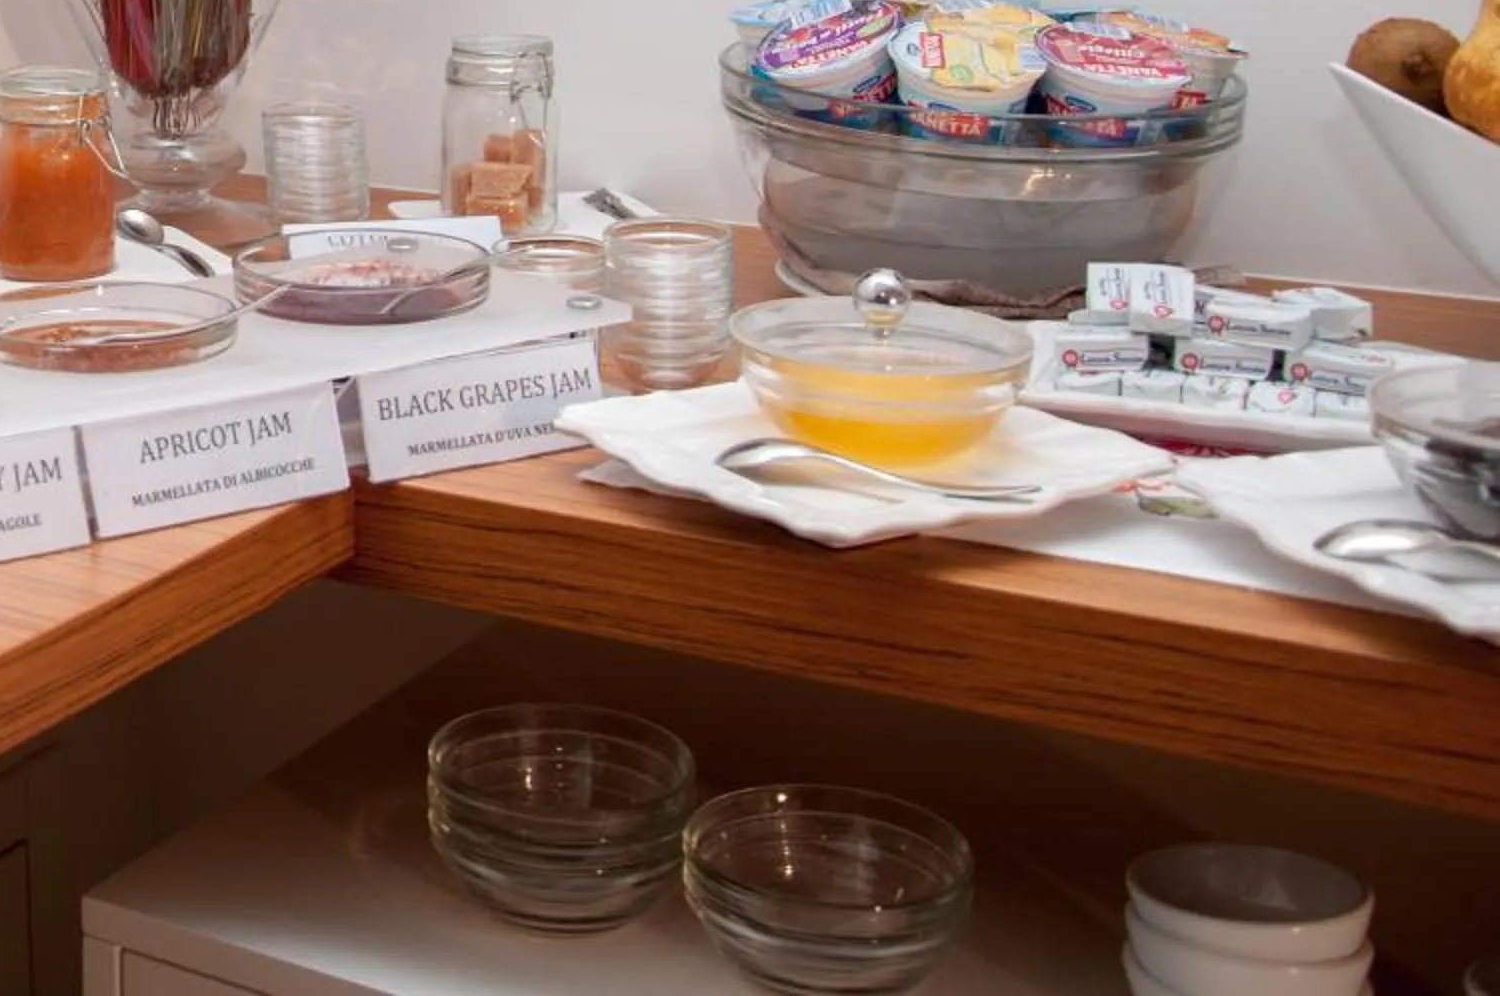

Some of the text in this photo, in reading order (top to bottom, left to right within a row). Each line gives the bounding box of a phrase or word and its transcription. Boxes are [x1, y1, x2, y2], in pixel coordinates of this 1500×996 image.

[377, 367, 593, 422] BLACK GRAPES JAM
[139, 411, 293, 465] APRICOT JAM
[407, 431, 493, 456] MARMELLATA
[12, 456, 64, 493] JAM
[131, 457, 316, 507] MARMELLATA DI ALBICOCCHE
